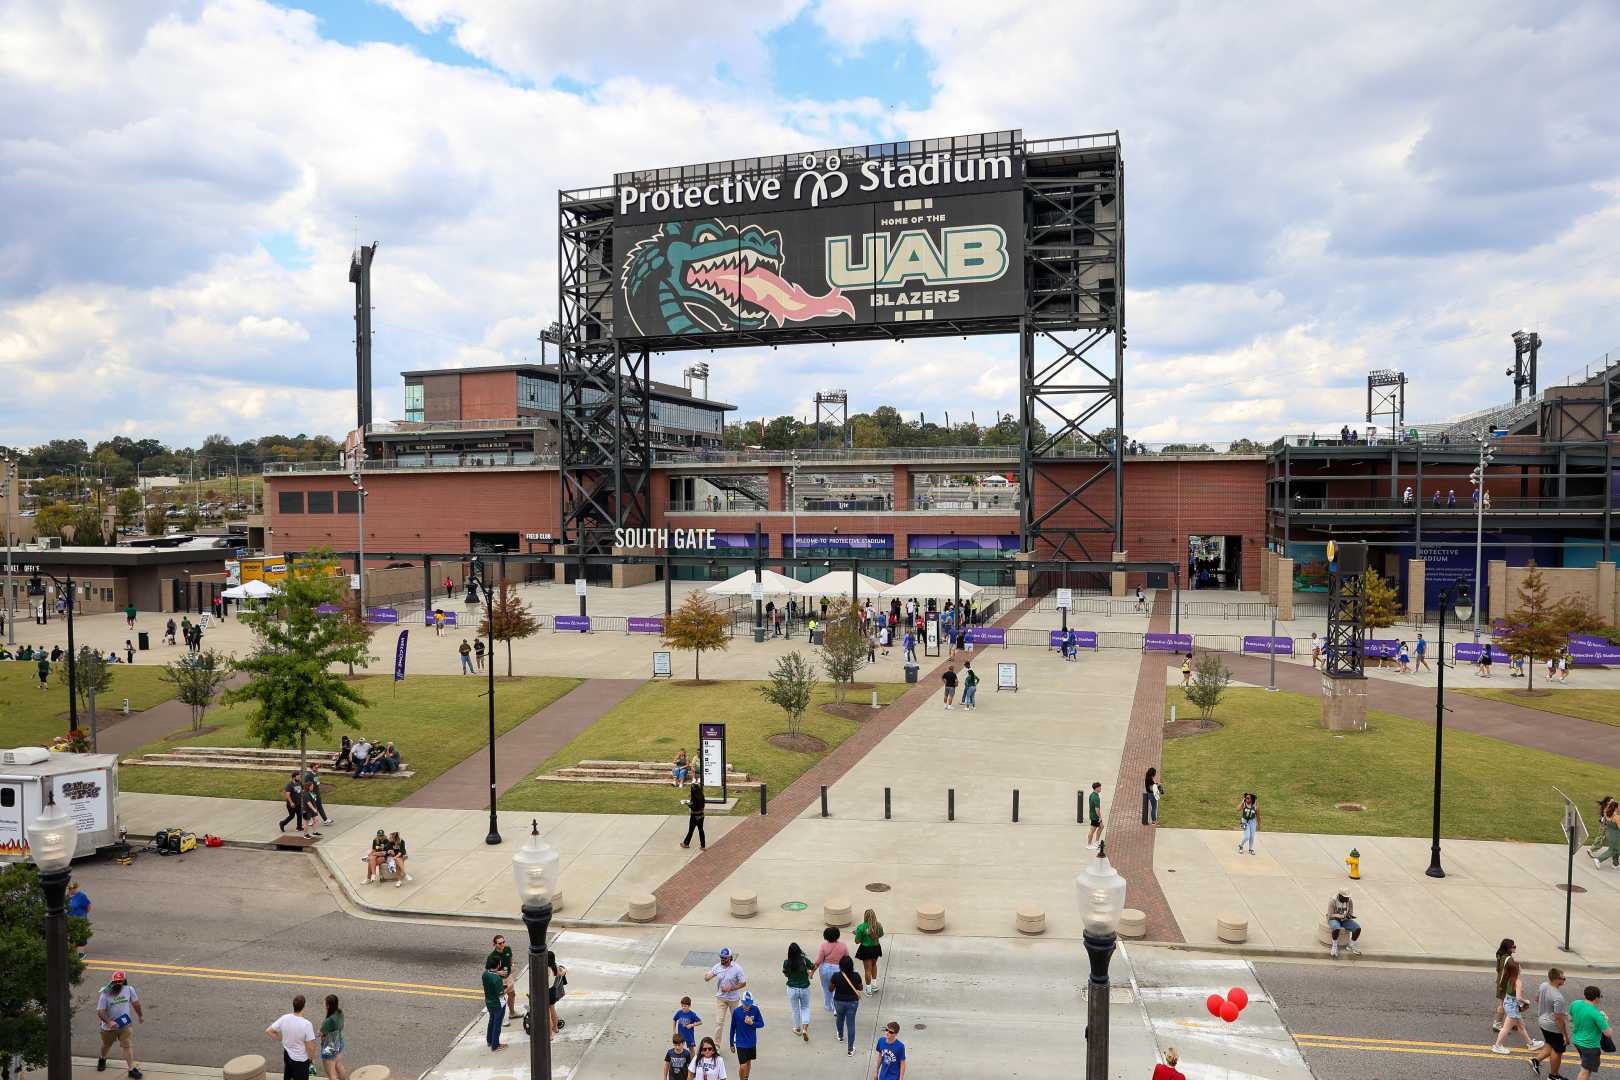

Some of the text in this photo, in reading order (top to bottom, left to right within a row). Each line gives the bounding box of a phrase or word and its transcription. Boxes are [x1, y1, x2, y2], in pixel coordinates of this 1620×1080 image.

[620, 154, 1012, 215] Protective Stadium
[881, 214, 946, 226] HOME OF THE
[825, 224, 1010, 291] UAB
[870, 290, 960, 307] BLAZERS
[614, 528, 717, 550] SOUTH GATE
